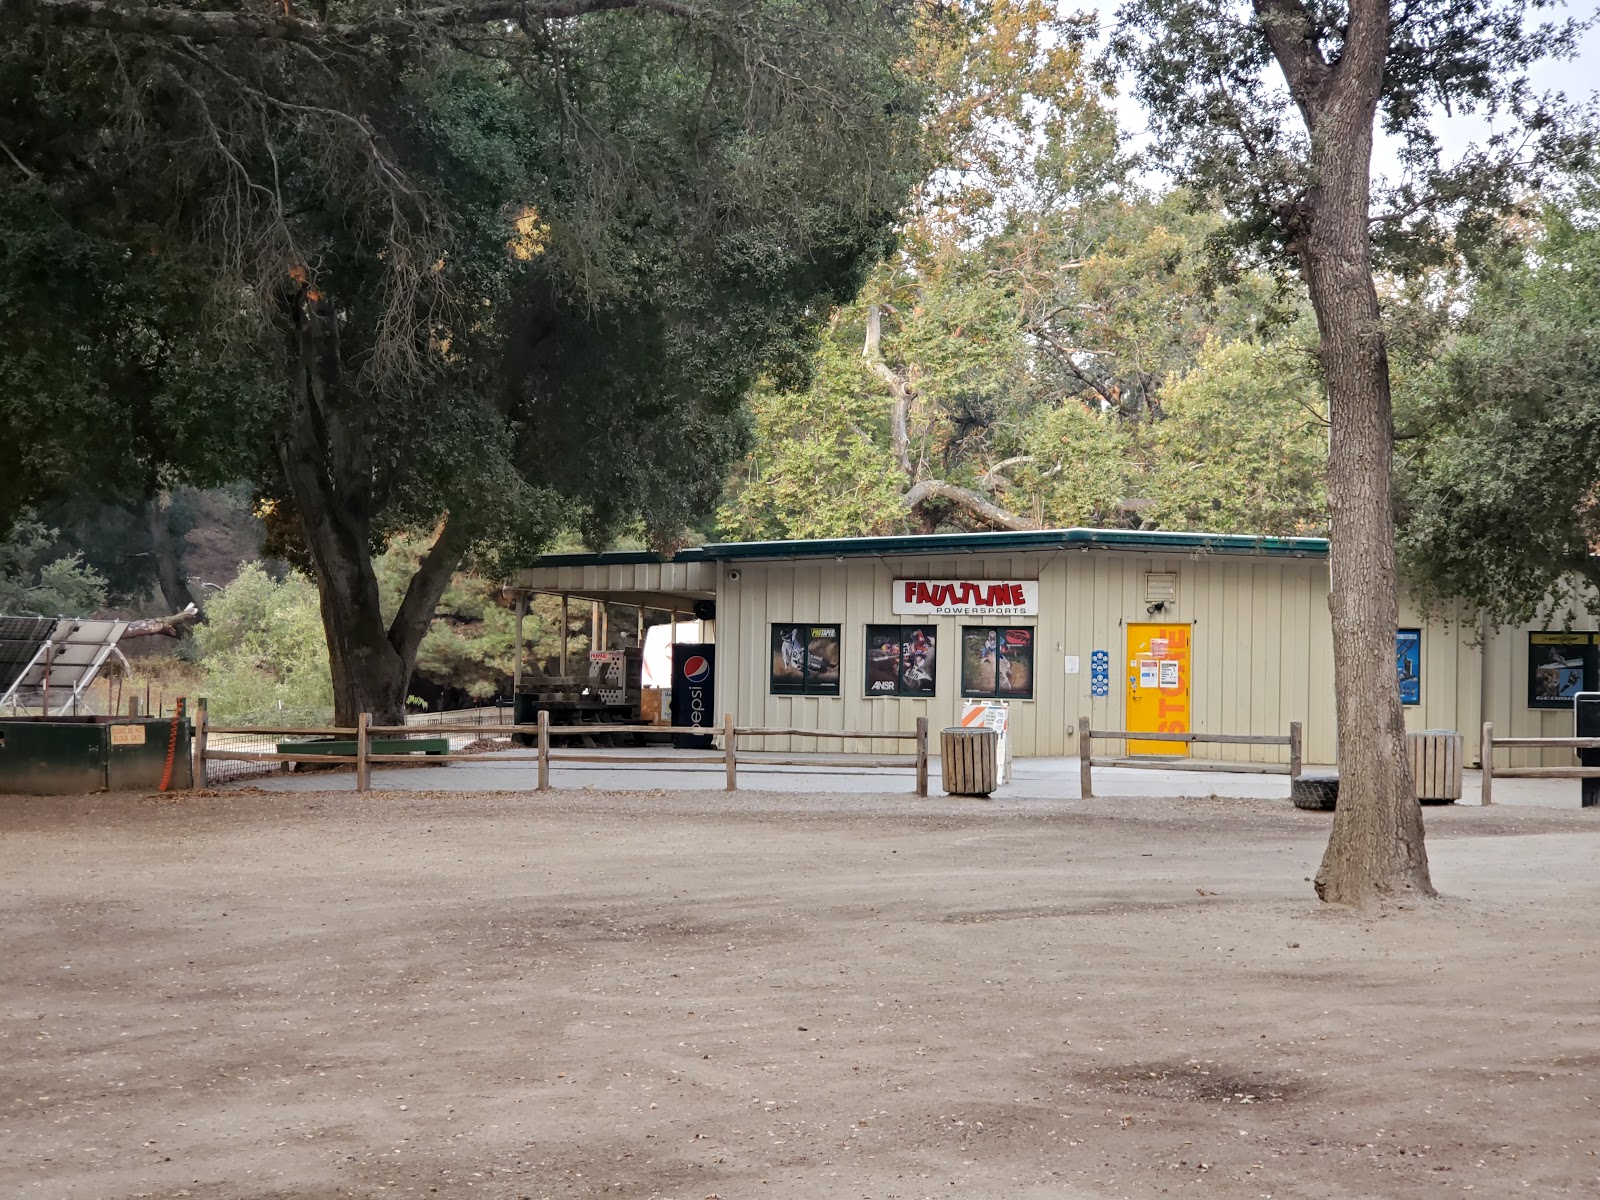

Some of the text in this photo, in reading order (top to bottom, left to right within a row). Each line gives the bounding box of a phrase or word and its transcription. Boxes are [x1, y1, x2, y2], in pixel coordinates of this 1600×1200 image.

[904, 581, 1026, 607] FAULTLINE
[871, 680, 895, 690] ANSR
[689, 686, 705, 736] pepsi
